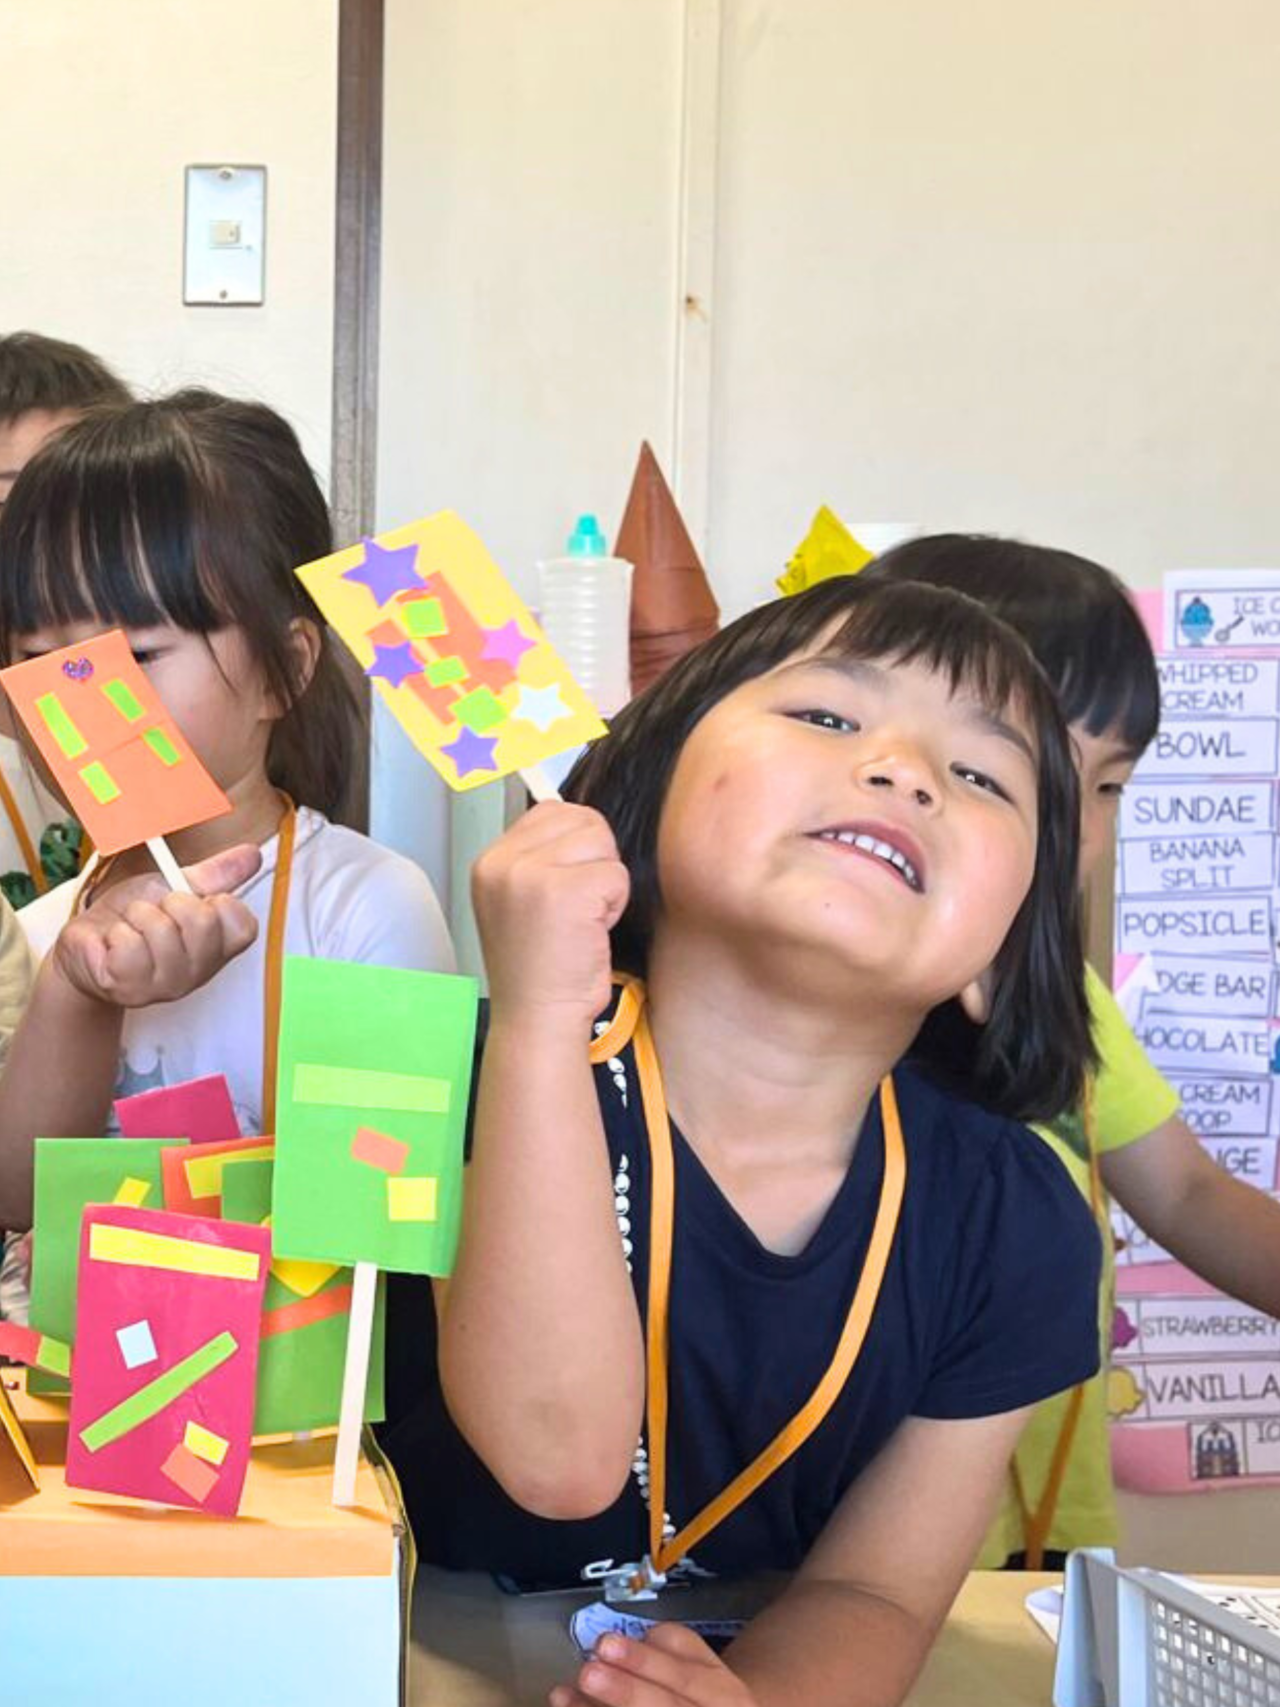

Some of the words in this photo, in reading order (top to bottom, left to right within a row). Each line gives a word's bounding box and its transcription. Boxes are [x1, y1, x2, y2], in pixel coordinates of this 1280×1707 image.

[1233, 596, 1265, 615] ICE
[1161, 690, 1243, 711] CREAM
[1156, 731, 1246, 759] BOWL
[1134, 796, 1256, 824] SUNDAE
[1150, 838, 1245, 863] BANANA
[1161, 866, 1235, 889] SPLIT
[1124, 910, 1266, 938] POPSICLE
[1156, 969, 1206, 996] DGE
[1215, 974, 1266, 999] BAR
[1133, 1026, 1269, 1056] HOCOLATE
[1180, 1083, 1261, 1104] CREAM
[1144, 1315, 1280, 1337] STRAWBERRY
[1150, 1373, 1280, 1403] VANILLA
